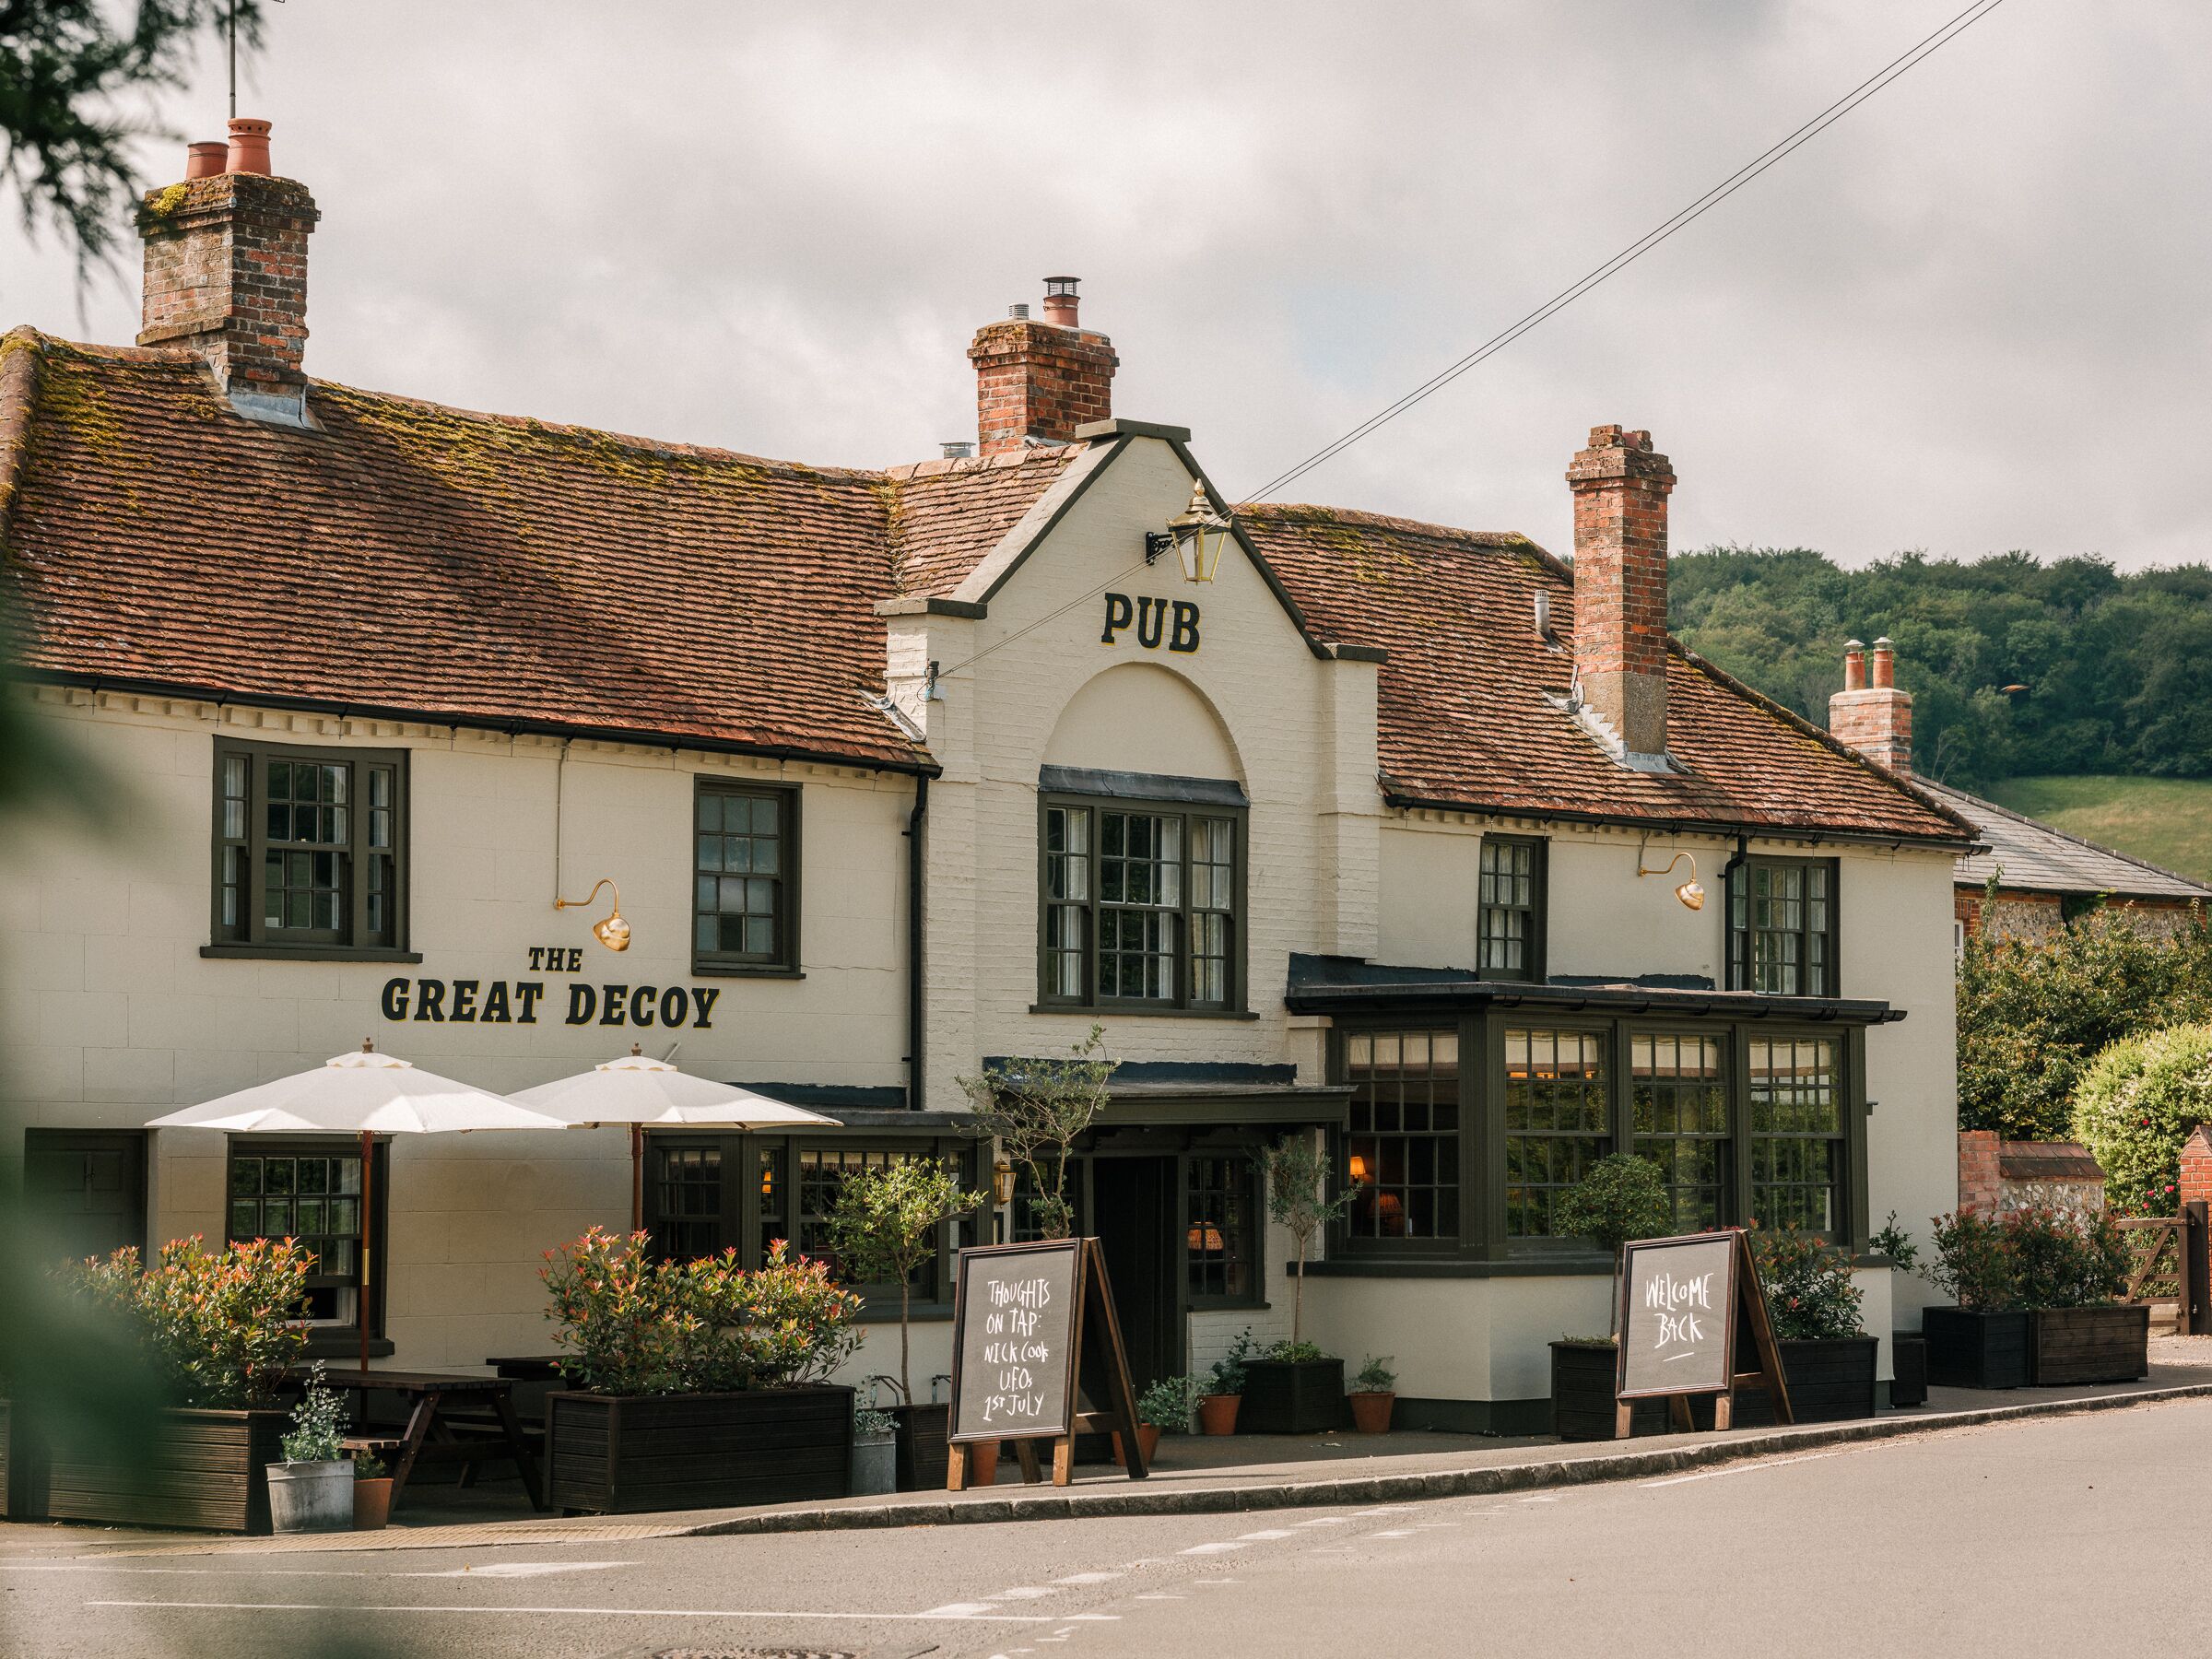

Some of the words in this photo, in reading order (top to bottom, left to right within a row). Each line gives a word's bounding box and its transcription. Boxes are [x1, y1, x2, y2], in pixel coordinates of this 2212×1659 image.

[1100, 593, 1201, 655] PUB
[528, 947, 583, 973] THE
[381, 977, 545, 1024] GREAT
[564, 982, 721, 1029] DECOY
[988, 1278, 1051, 1309] THOUGHTS
[1645, 1272, 1714, 1312] WELCOME
[986, 1313, 1004, 1335] ON
[1009, 1307, 1041, 1337] TAP:
[1653, 1312, 1704, 1349] BACK
[983, 1340, 1018, 1364] NICK
[1006, 1391, 1044, 1418] JULY
